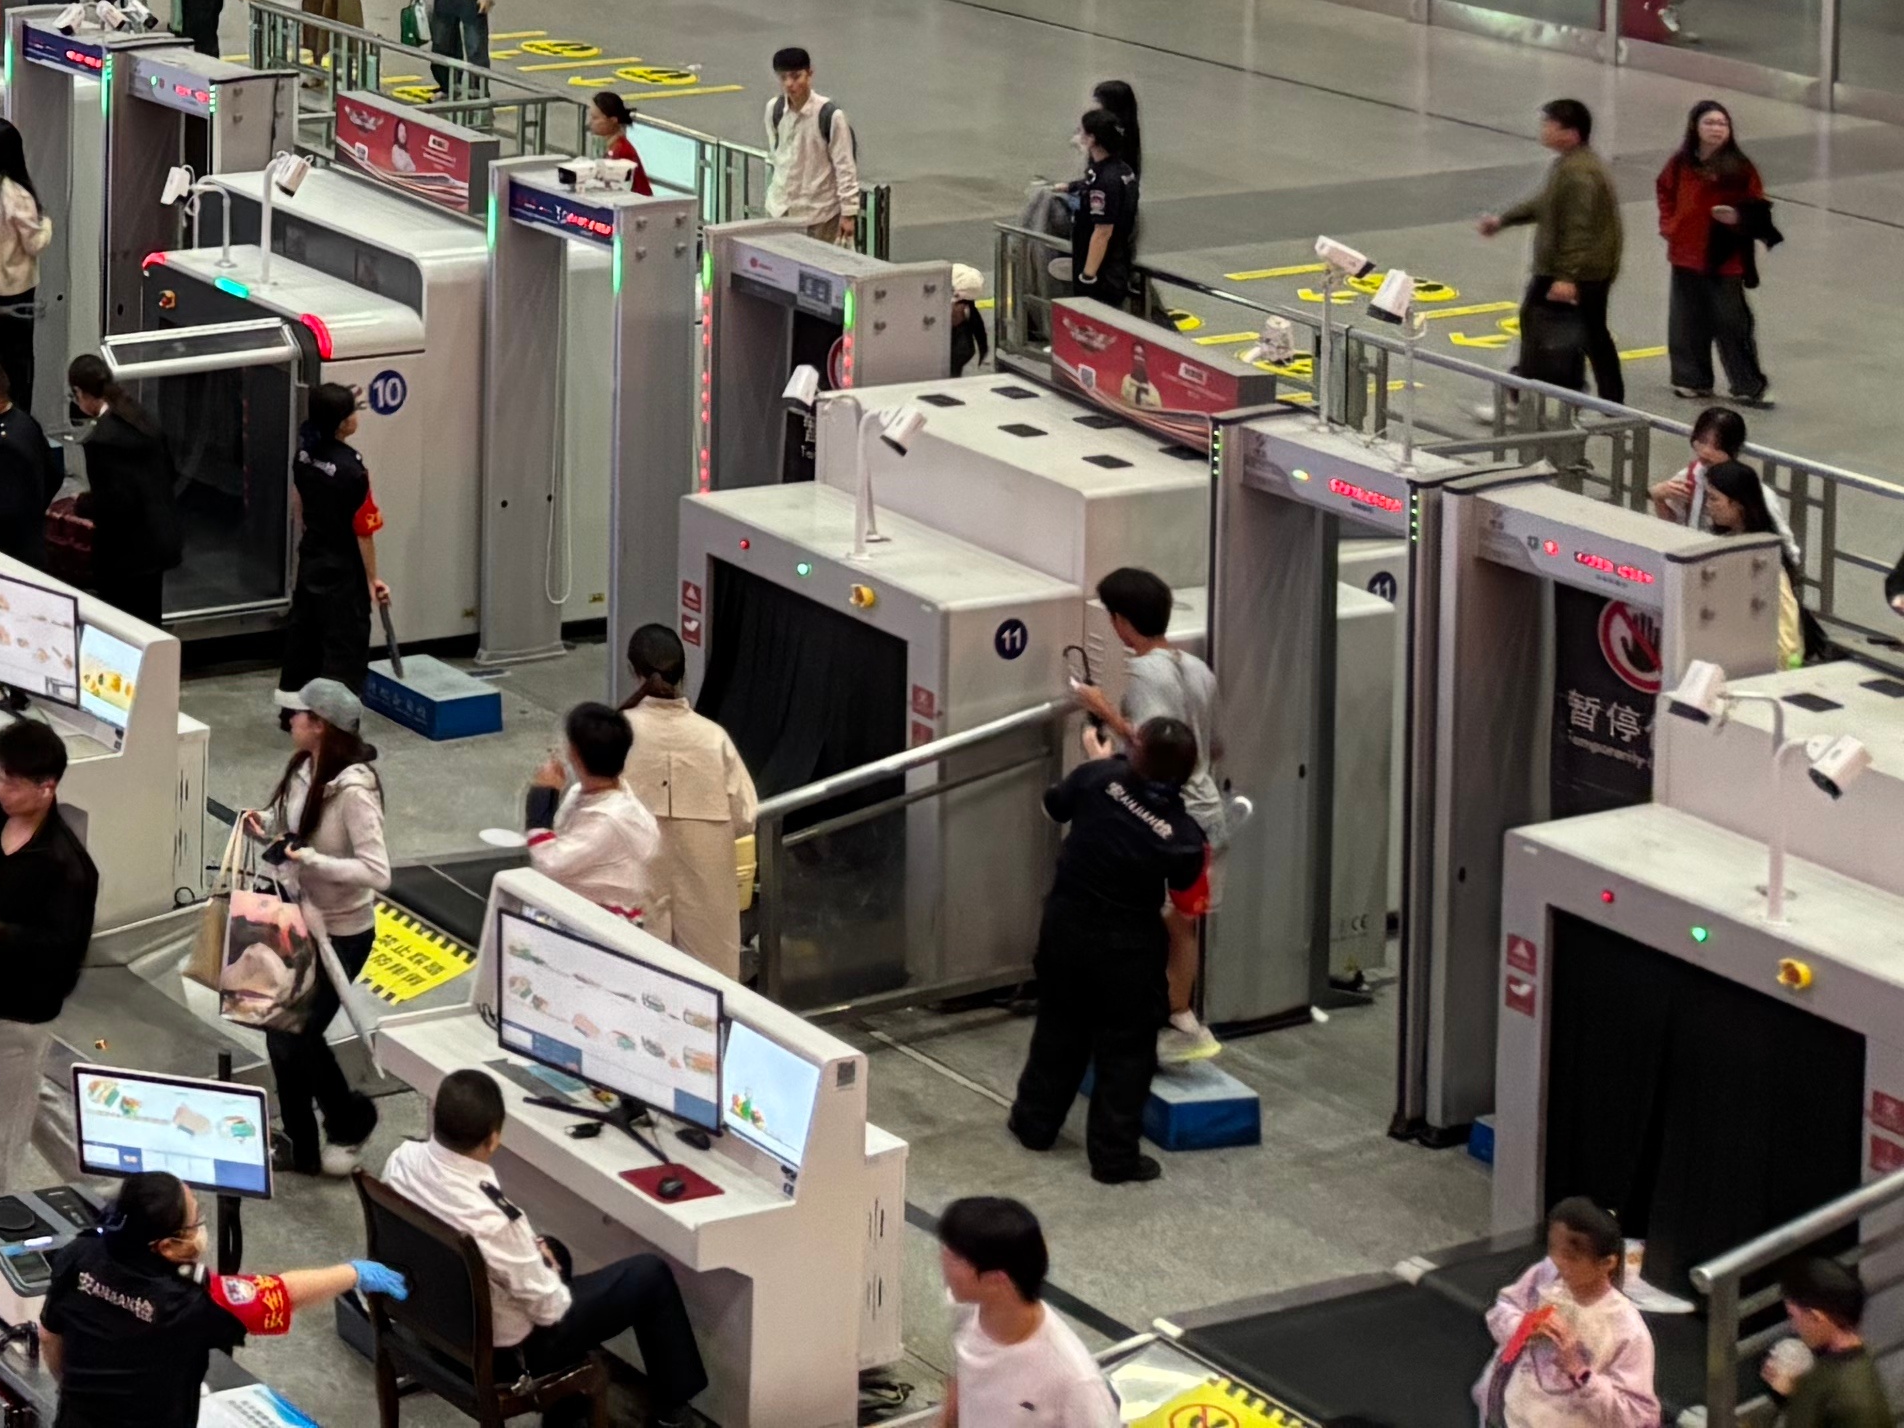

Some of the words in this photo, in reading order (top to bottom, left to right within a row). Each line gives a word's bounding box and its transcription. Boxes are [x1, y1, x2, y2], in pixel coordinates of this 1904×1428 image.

[373, 377, 402, 407] 10
[1001, 628, 1022, 651] 11
[1567, 689, 1655, 743] 暂停
